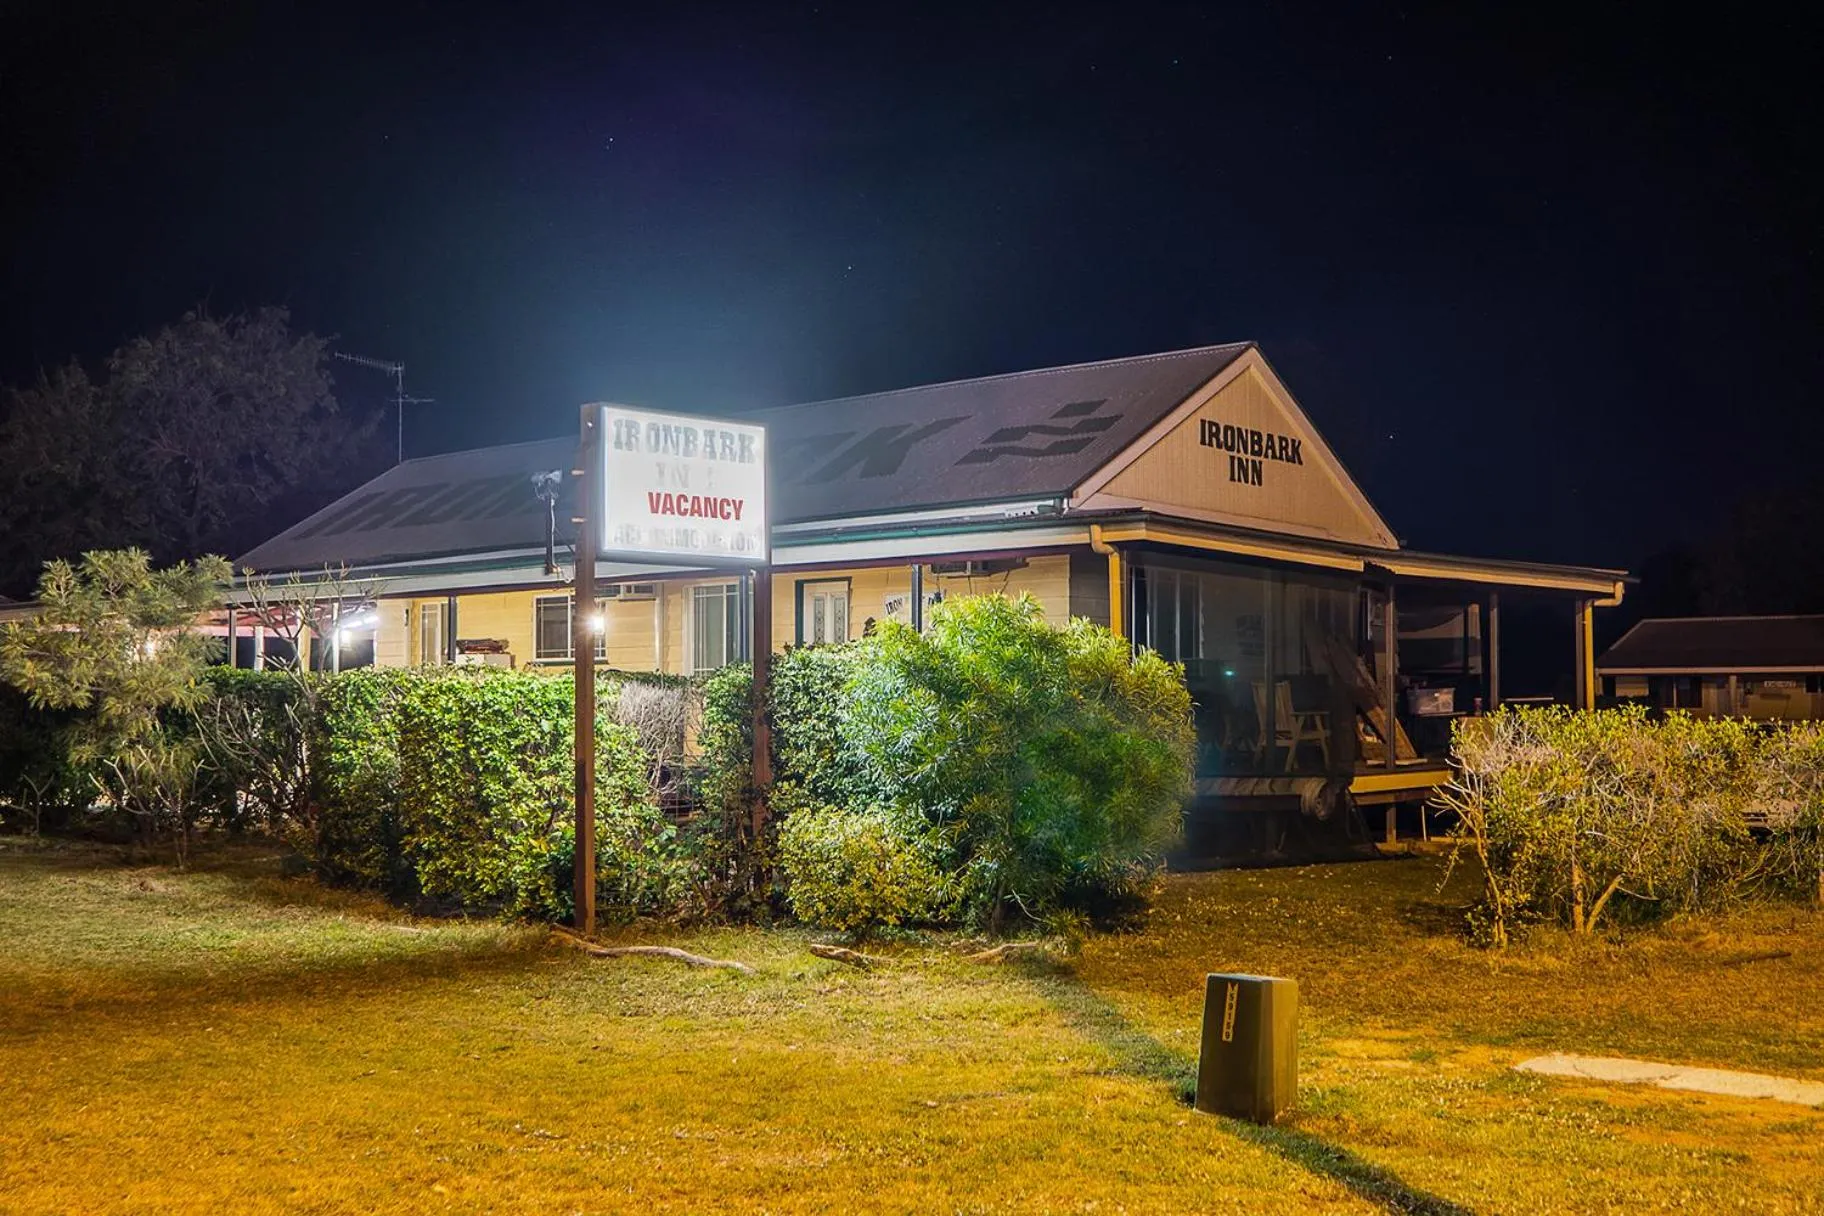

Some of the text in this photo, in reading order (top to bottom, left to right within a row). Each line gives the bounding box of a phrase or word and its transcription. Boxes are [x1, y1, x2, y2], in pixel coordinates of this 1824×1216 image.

[613, 418, 757, 464] IRONBARK
[1199, 418, 1304, 466] IRONBARK
[1228, 454, 1263, 487] INN
[648, 491, 744, 521] VACANCY
